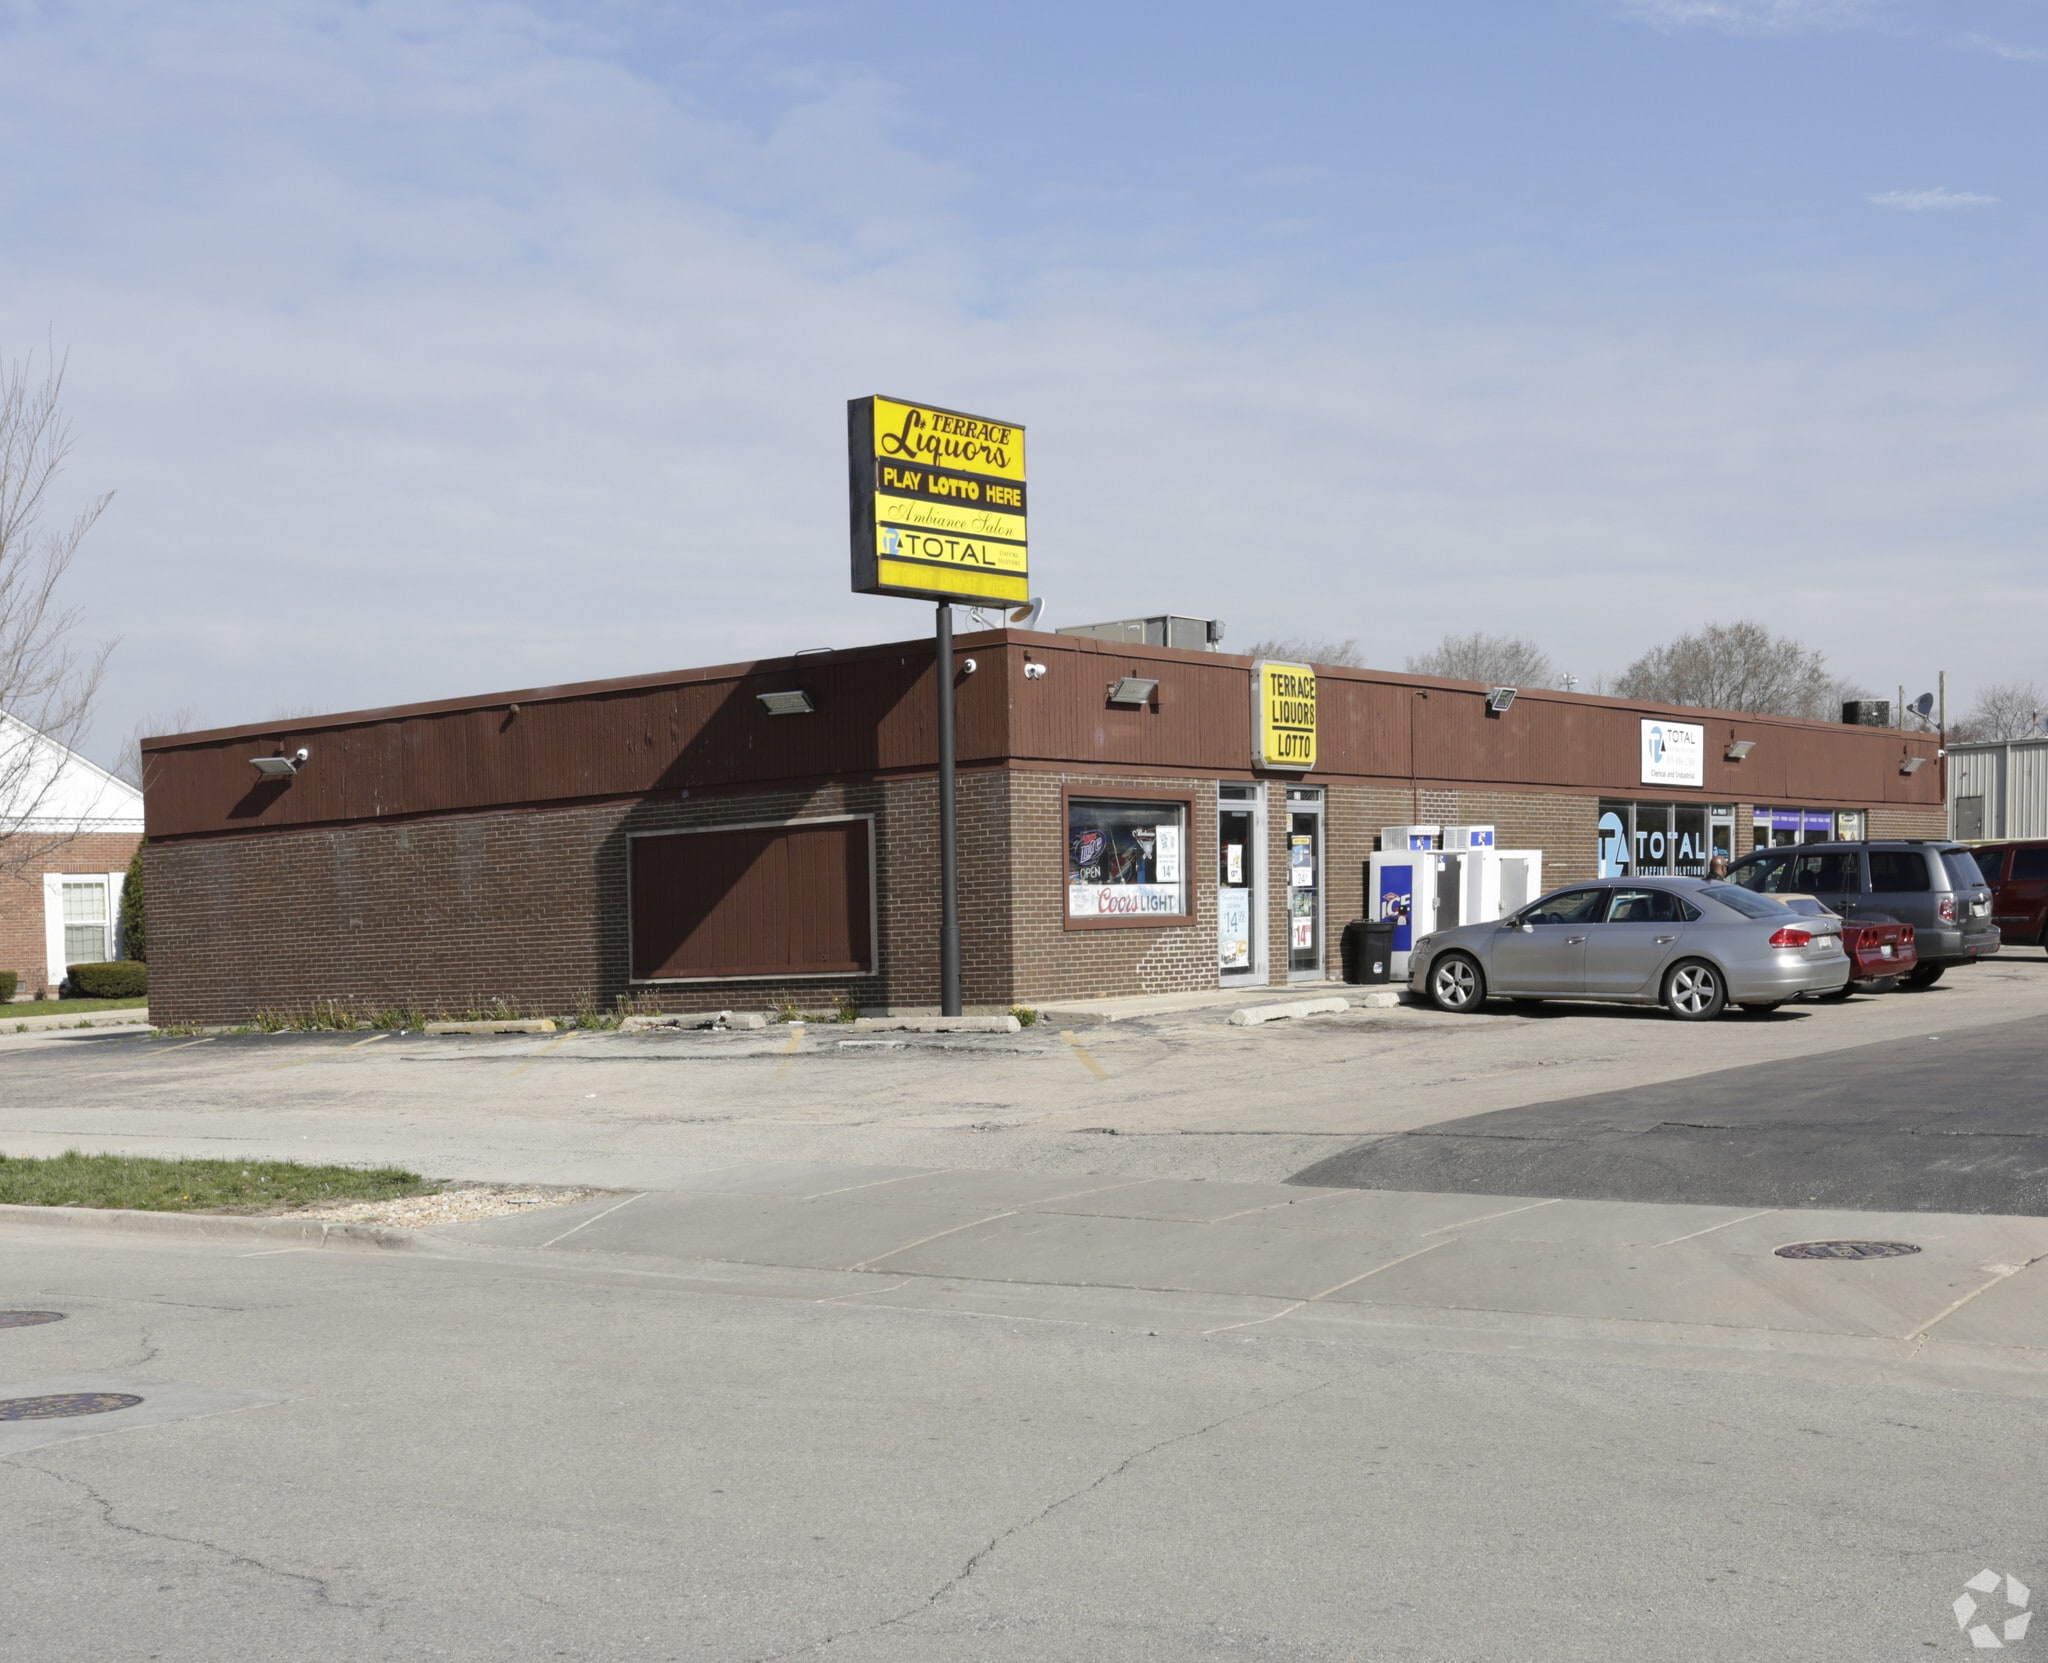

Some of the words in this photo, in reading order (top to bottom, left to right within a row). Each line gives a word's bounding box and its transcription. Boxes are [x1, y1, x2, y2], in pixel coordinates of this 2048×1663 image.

[881, 408, 1011, 469] Liquors
[931, 413, 1011, 446] TERRACE
[883, 467, 922, 491] PLAY
[928, 474, 980, 501] LOTTO
[986, 484, 1022, 507] HERE
[888, 501, 967, 529] Ambiance
[971, 511, 1014, 537] Salon
[905, 533, 996, 566] TOTAL
[1270, 672, 1315, 700] TERRACE
[1272, 700, 1315, 726] LIQUORS
[1278, 733, 1311, 758] LOTTO
[1667, 729, 1696, 745] TOTAL
[1636, 831, 1706, 859] TOTAL
[1080, 866, 1101, 881] OPEN
[1636, 865, 1667, 877] STAFFING
[1671, 865, 1706, 876] OLUTIONS
[1097, 887, 1139, 913] Coors
[1140, 894, 1174, 912] LIGHT
